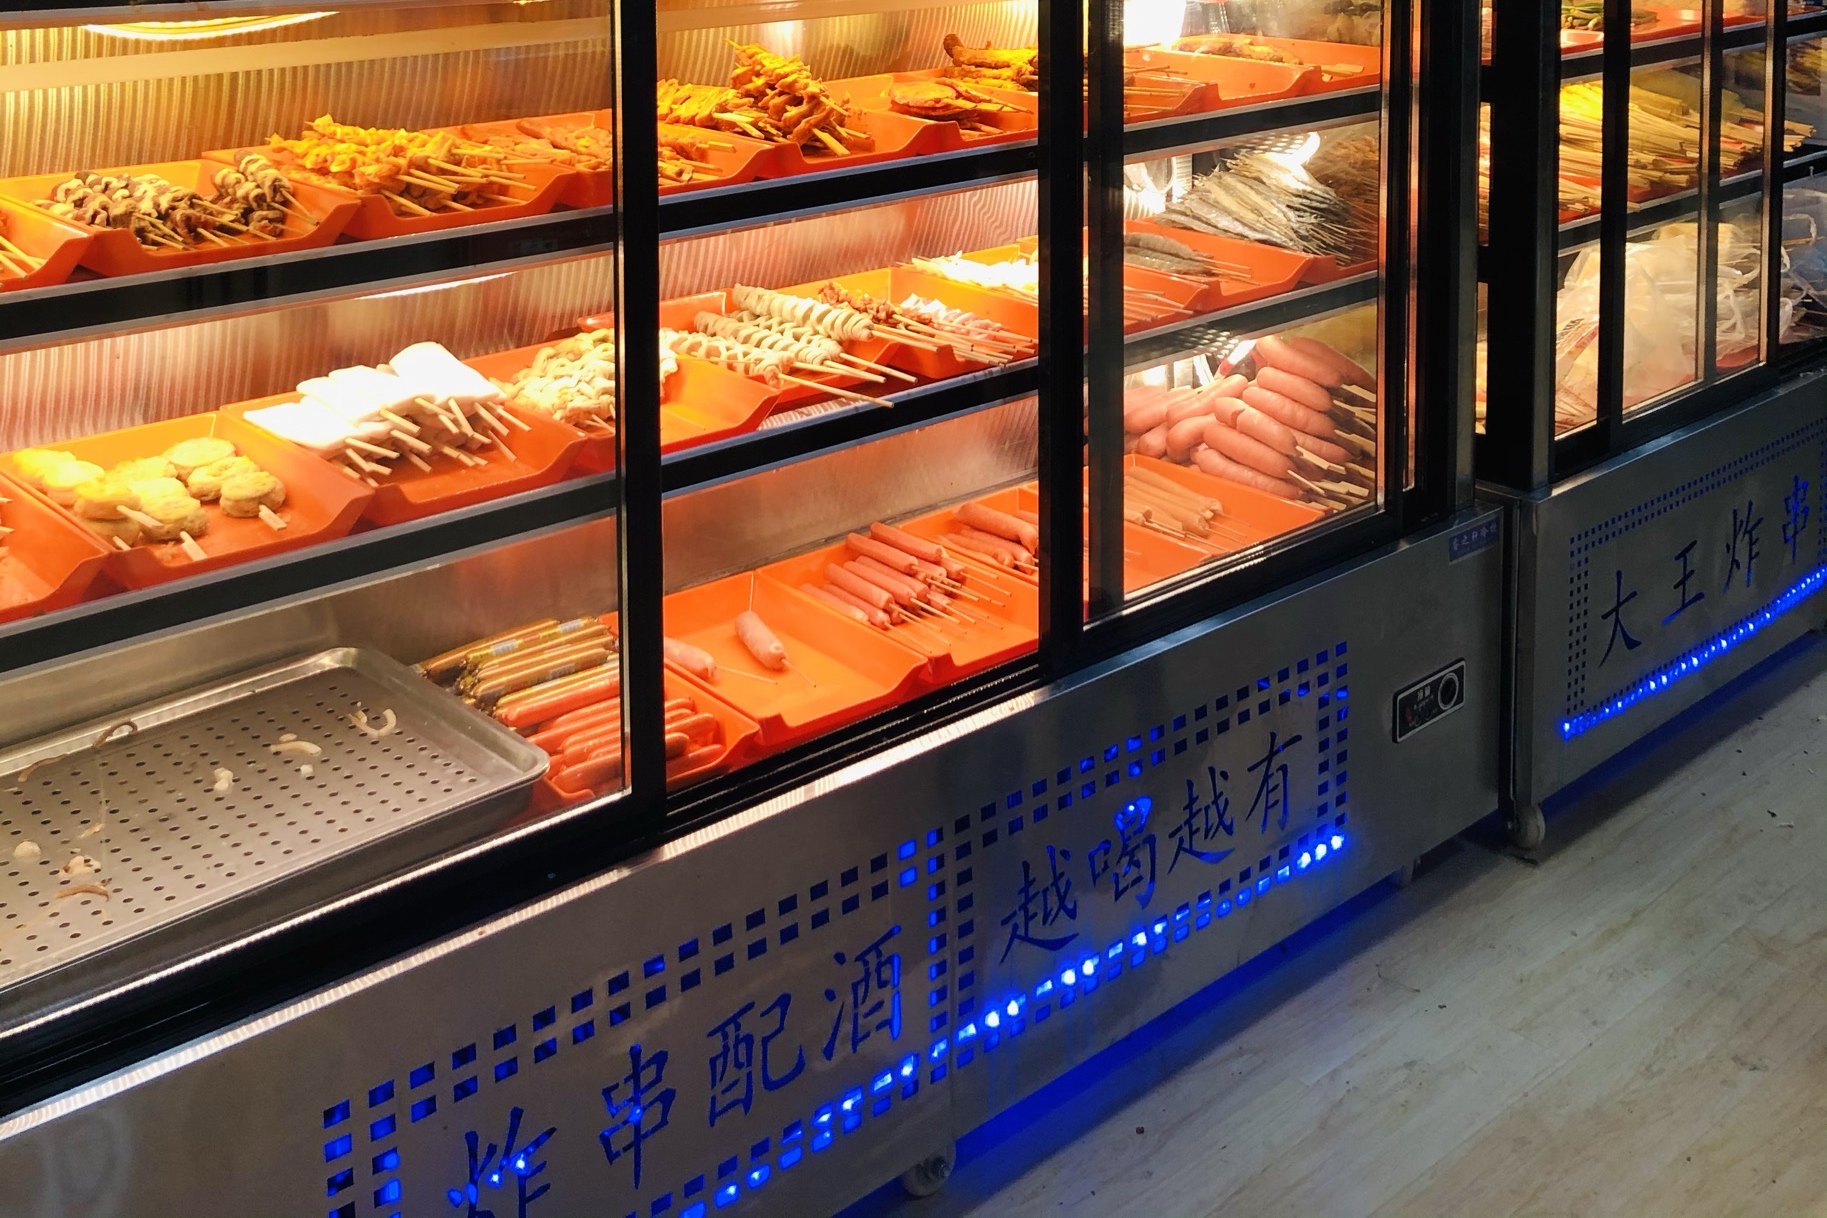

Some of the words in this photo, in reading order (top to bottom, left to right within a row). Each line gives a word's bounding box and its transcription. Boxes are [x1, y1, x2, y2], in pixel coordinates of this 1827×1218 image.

[1599, 475, 1809, 669] 大王炸串
[1000, 730, 1303, 965] 越喝越有
[447, 925, 904, 1218] 炸串配酒
